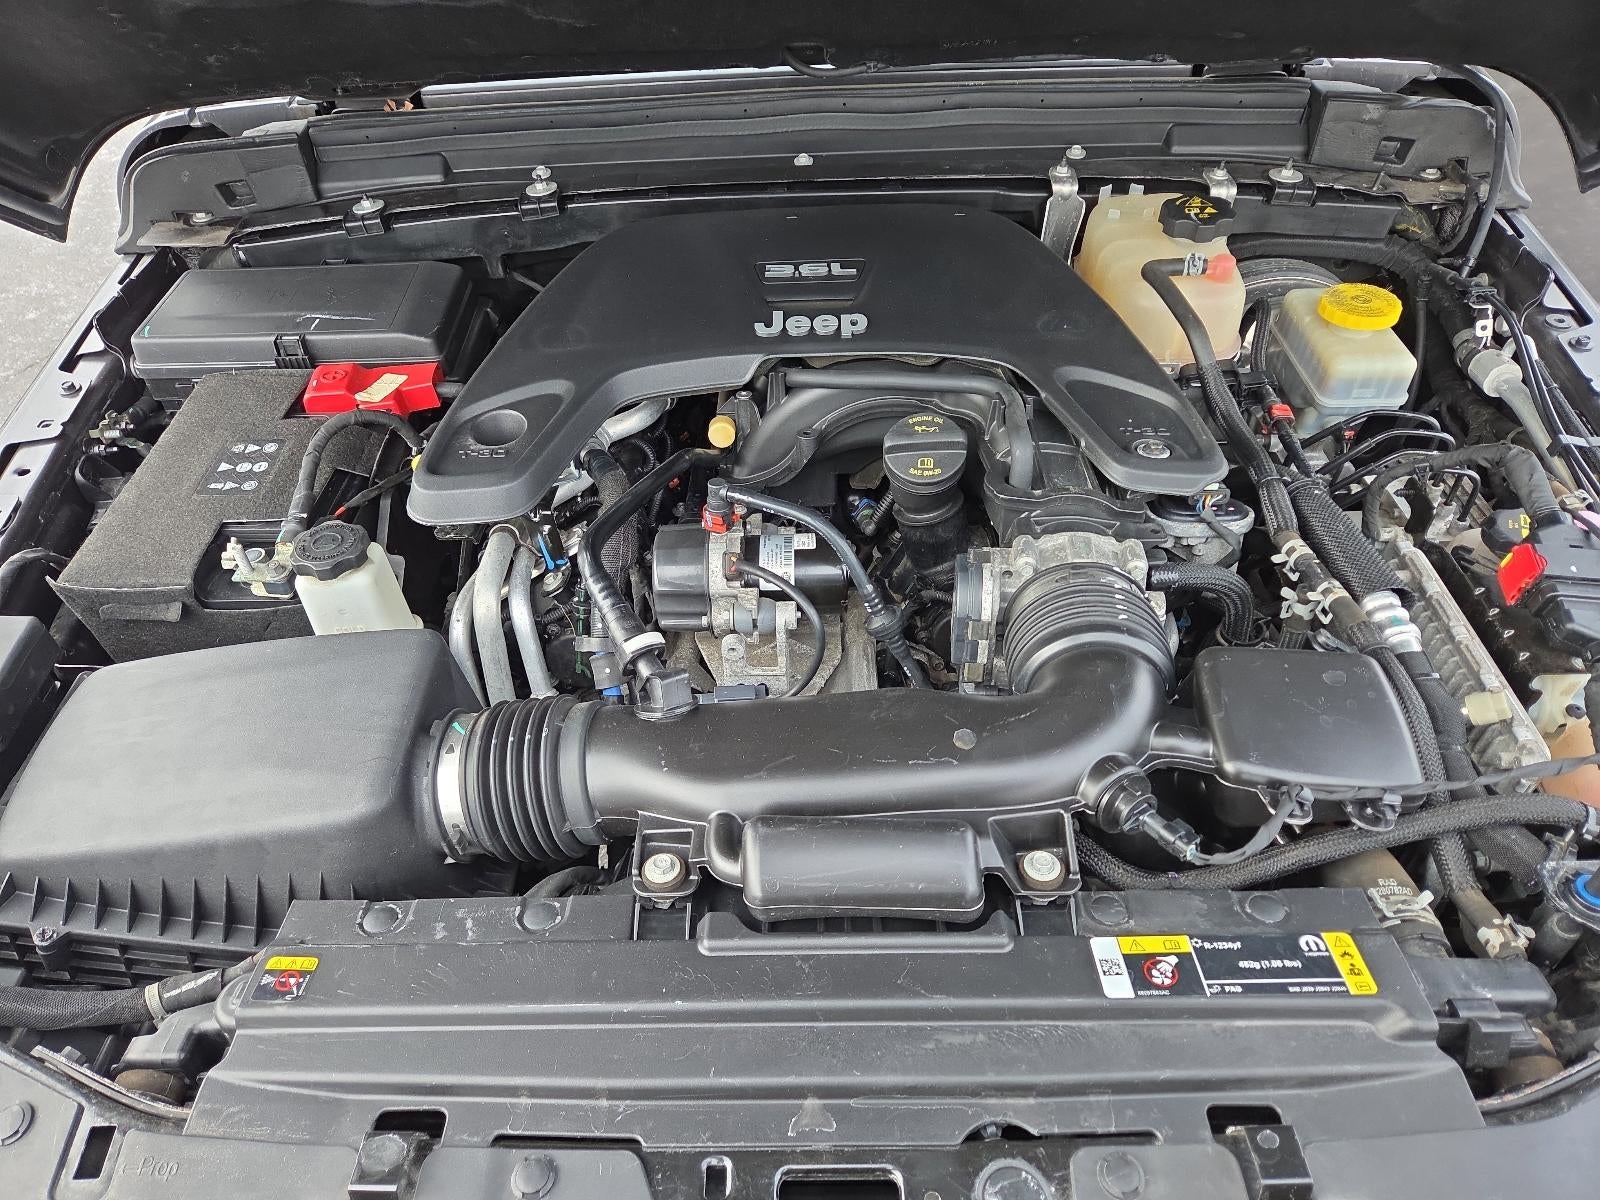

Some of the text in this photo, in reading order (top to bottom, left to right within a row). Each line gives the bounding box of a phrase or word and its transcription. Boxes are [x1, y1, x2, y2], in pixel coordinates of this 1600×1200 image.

[765, 262, 857, 278] 3.6L
[754, 310, 868, 339] Jeep
[908, 415, 944, 424] ENGINE OIL
[909, 467, 923, 475] SAE
[1377, 878, 1398, 887] RAD
[137, 1155, 181, 1182] Prop
